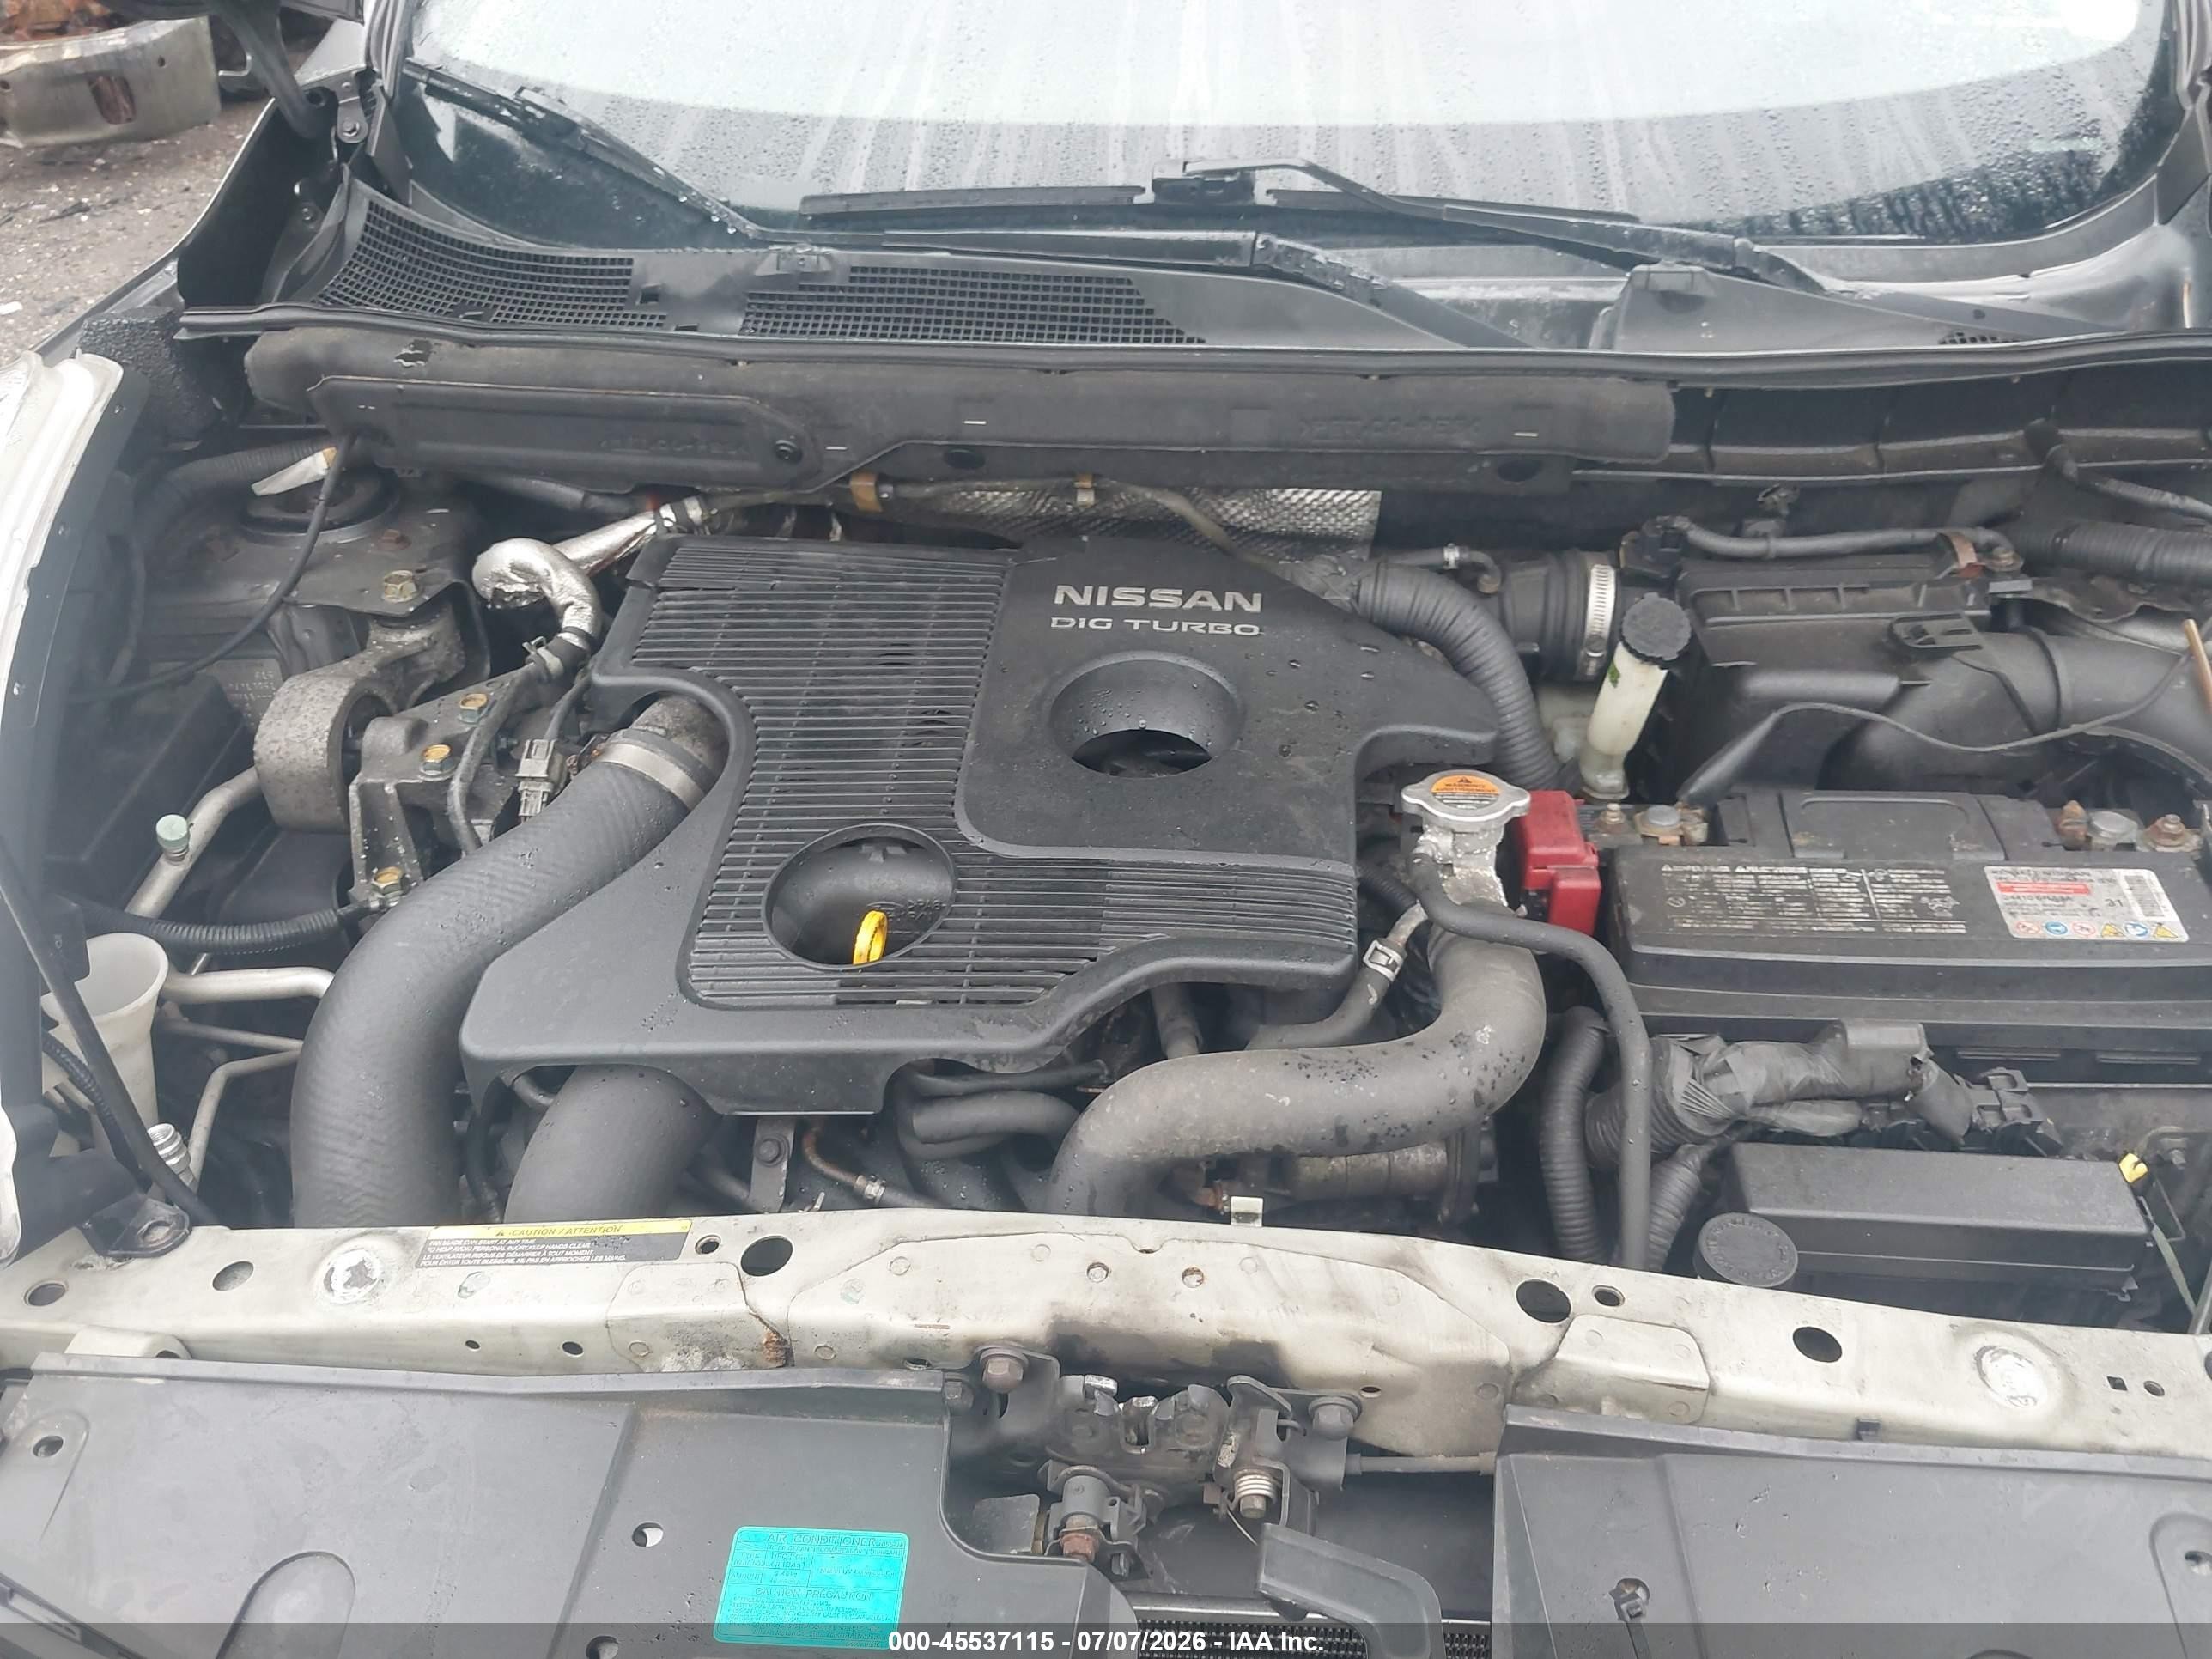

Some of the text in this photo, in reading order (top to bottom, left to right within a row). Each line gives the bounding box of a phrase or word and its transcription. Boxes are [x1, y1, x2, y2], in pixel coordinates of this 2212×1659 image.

[1054, 585, 1262, 613] NISSAN
[1051, 617, 1261, 636] DIG TURBO
[511, 1228, 556, 1237] CAUTION
[564, 1224, 623, 1234] ATTENTION
[768, 1534, 787, 1544] AIR
[793, 1534, 877, 1547] CONDITIONER
[755, 1587, 873, 1601] CAUTION PRECAUTION
